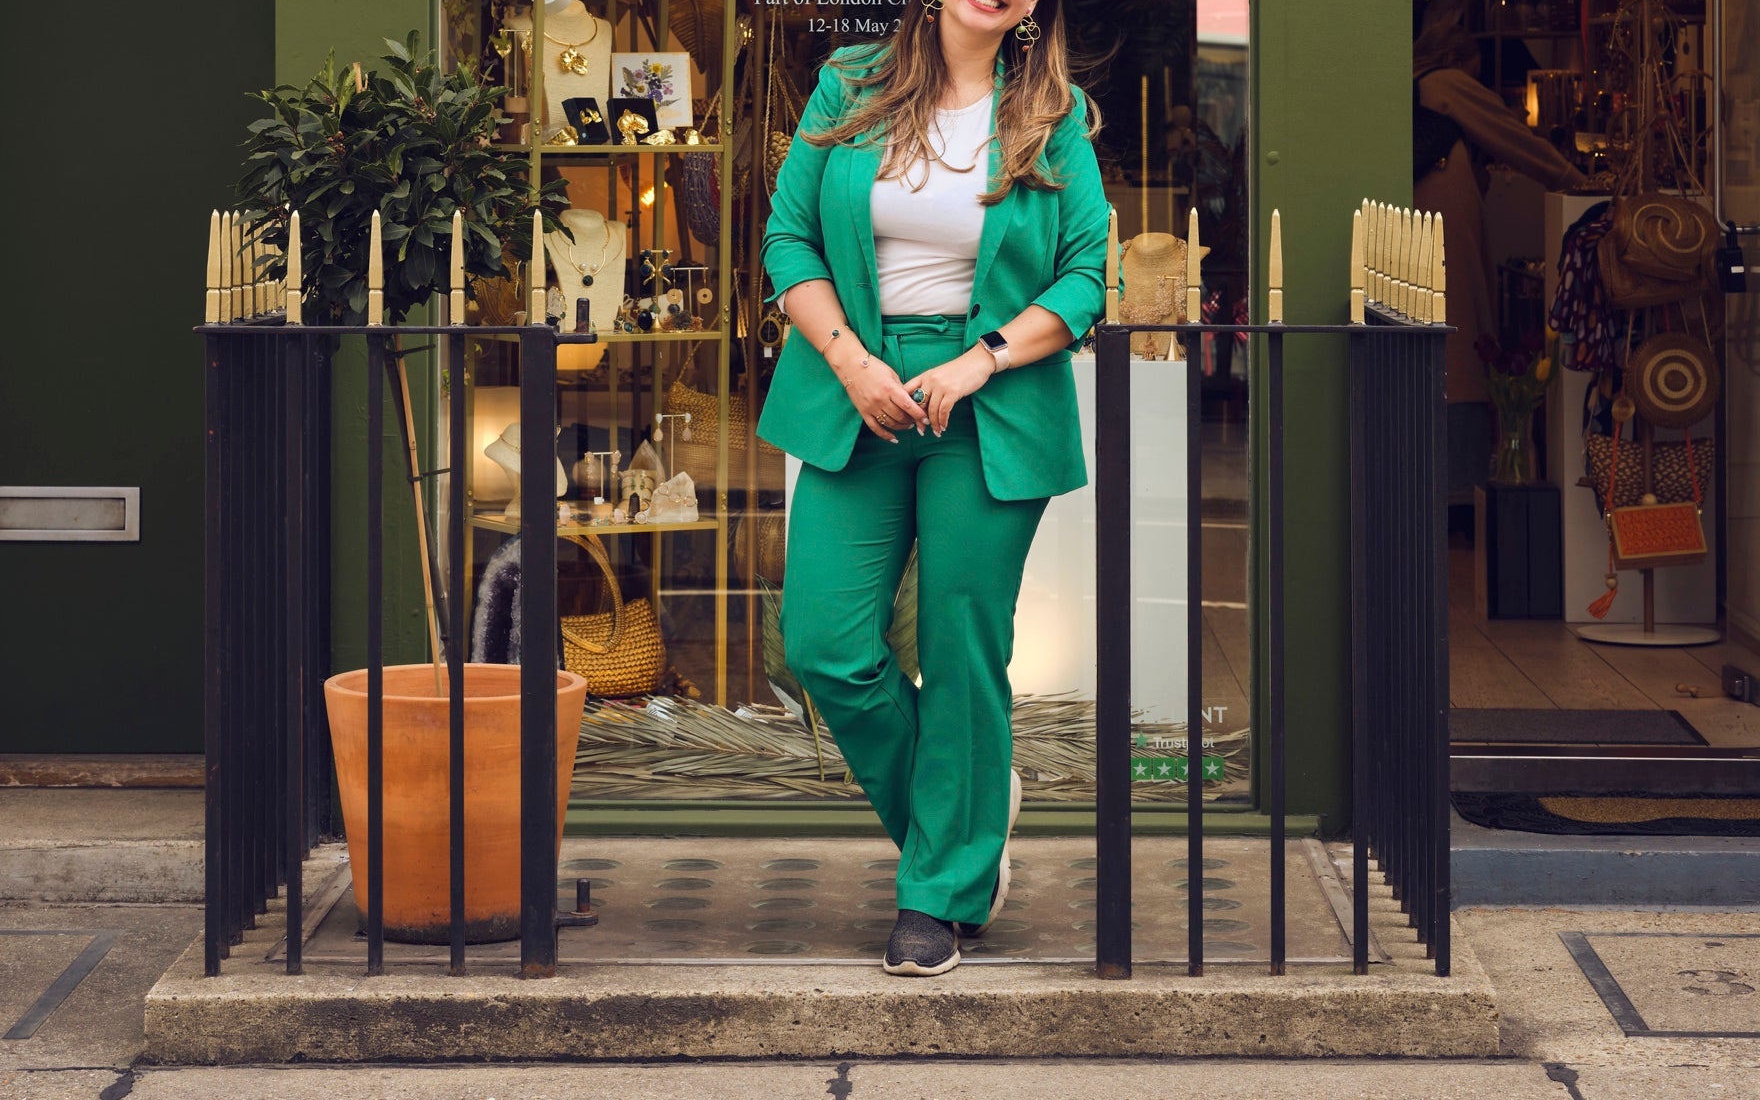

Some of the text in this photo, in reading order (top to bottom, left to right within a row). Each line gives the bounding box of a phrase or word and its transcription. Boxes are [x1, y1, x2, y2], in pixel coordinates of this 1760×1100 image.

[808, 18, 850, 33] 12-18
[855, 18, 889, 37] May
[1152, 736, 1215, 751] Trustot
